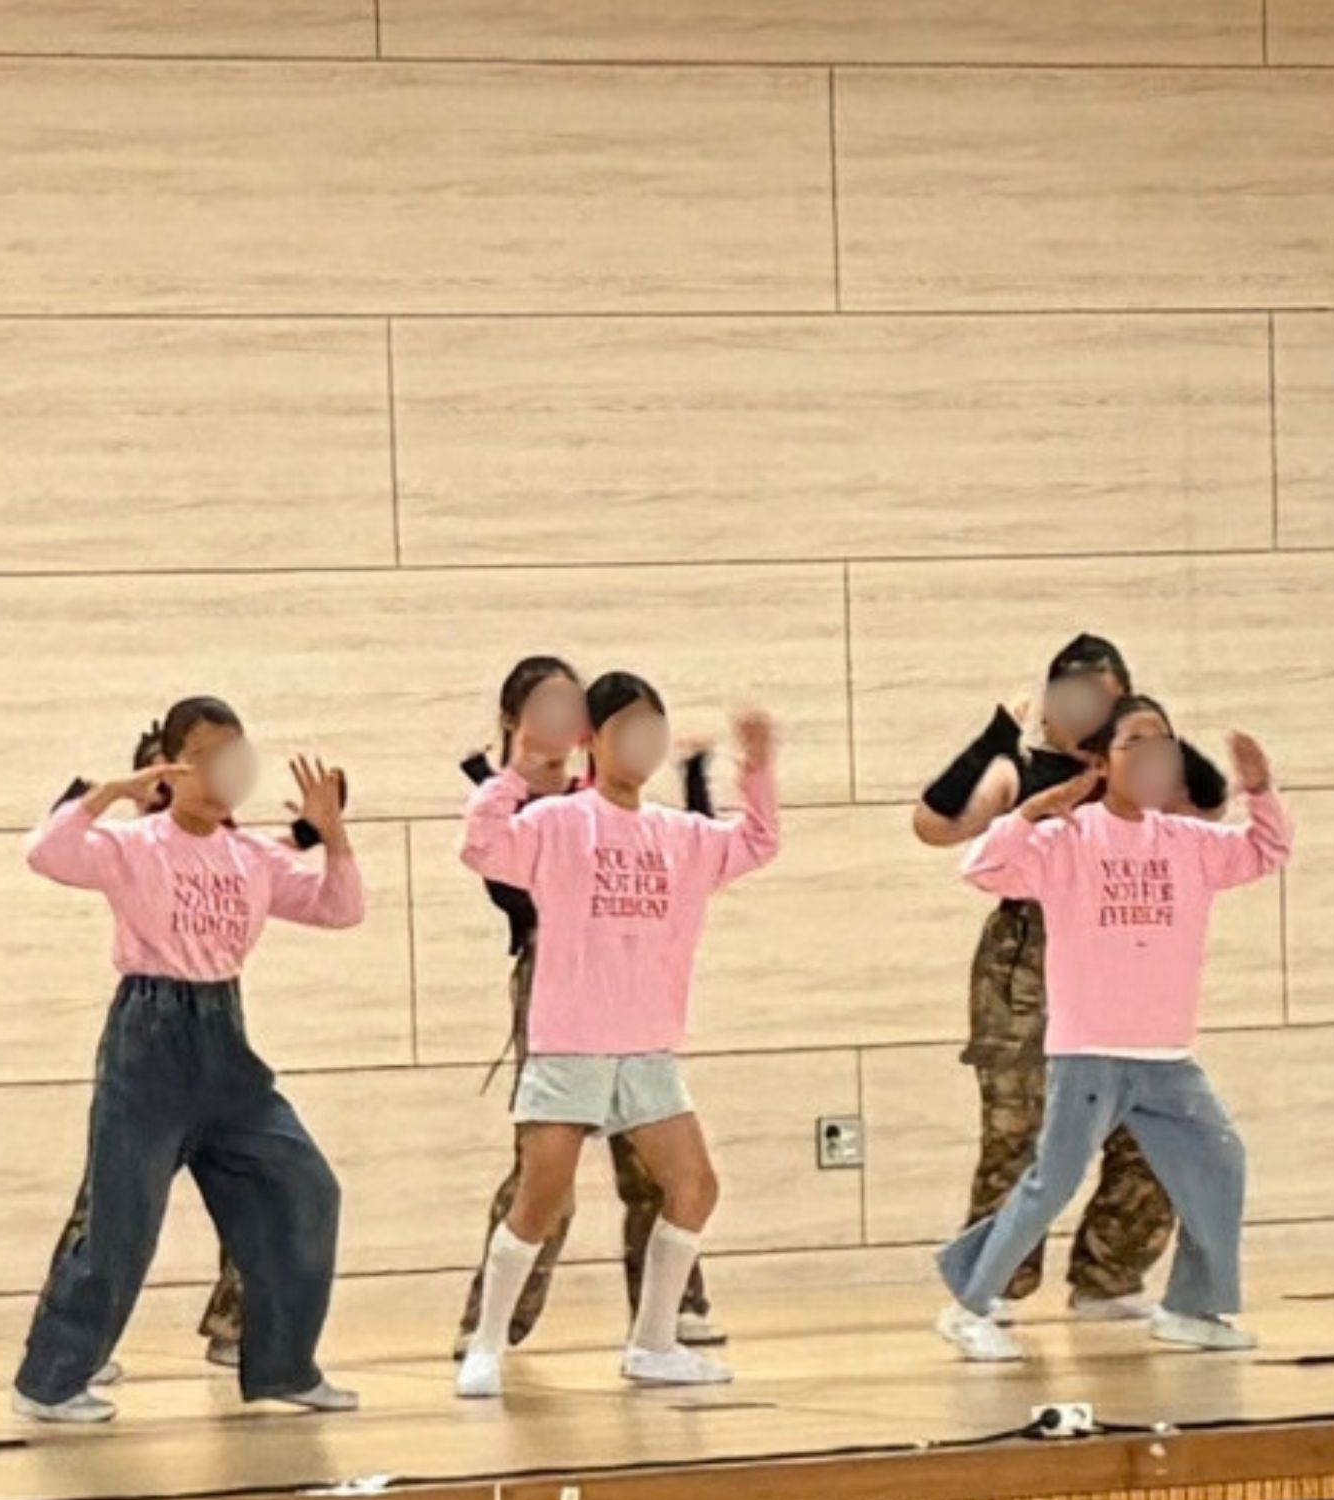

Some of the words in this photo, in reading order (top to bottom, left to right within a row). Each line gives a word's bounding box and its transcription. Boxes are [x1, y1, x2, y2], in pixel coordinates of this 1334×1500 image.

[594, 848, 629, 869] YOU
[1100, 858, 1139, 879] YOU
[594, 872, 632, 893] NOT
[634, 874, 670, 895] FOR
[1102, 881, 1138, 902] NOT
